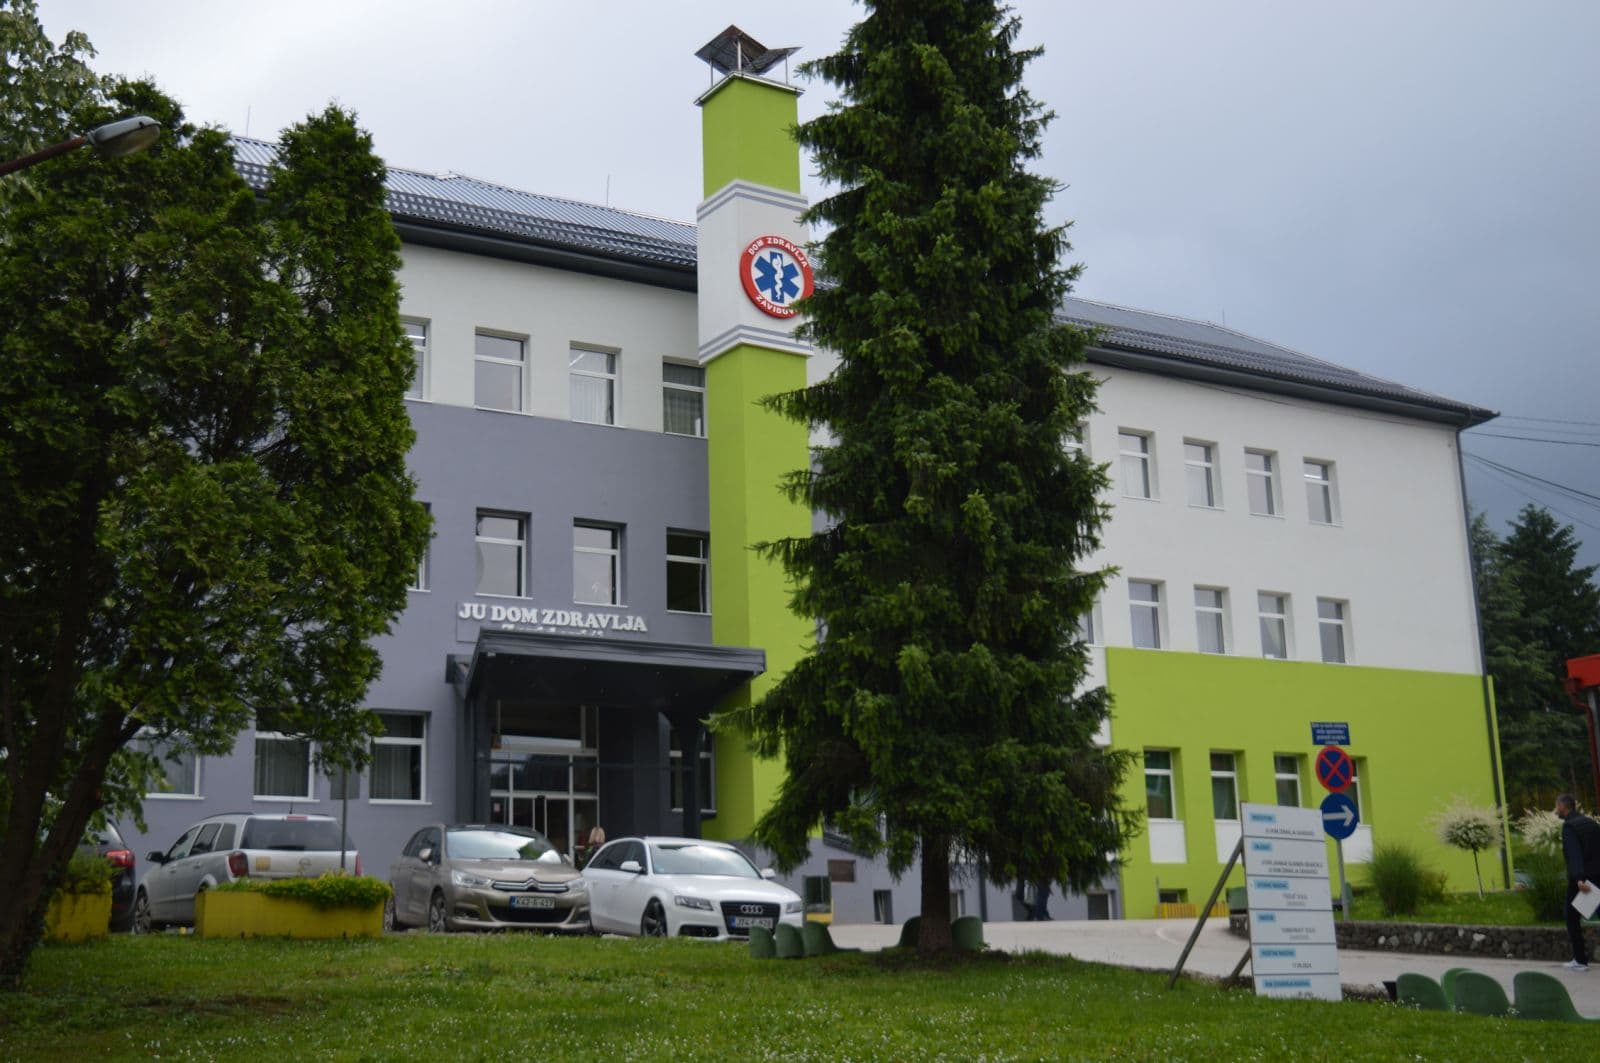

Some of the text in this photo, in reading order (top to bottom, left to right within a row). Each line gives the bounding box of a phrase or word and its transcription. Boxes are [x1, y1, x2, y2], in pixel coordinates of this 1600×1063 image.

[748, 237, 808, 268] DOM ZDRAVLJA
[459, 603, 486, 620] JU
[491, 605, 538, 624] DOM
[542, 609, 648, 633] ZDRAVLJA
